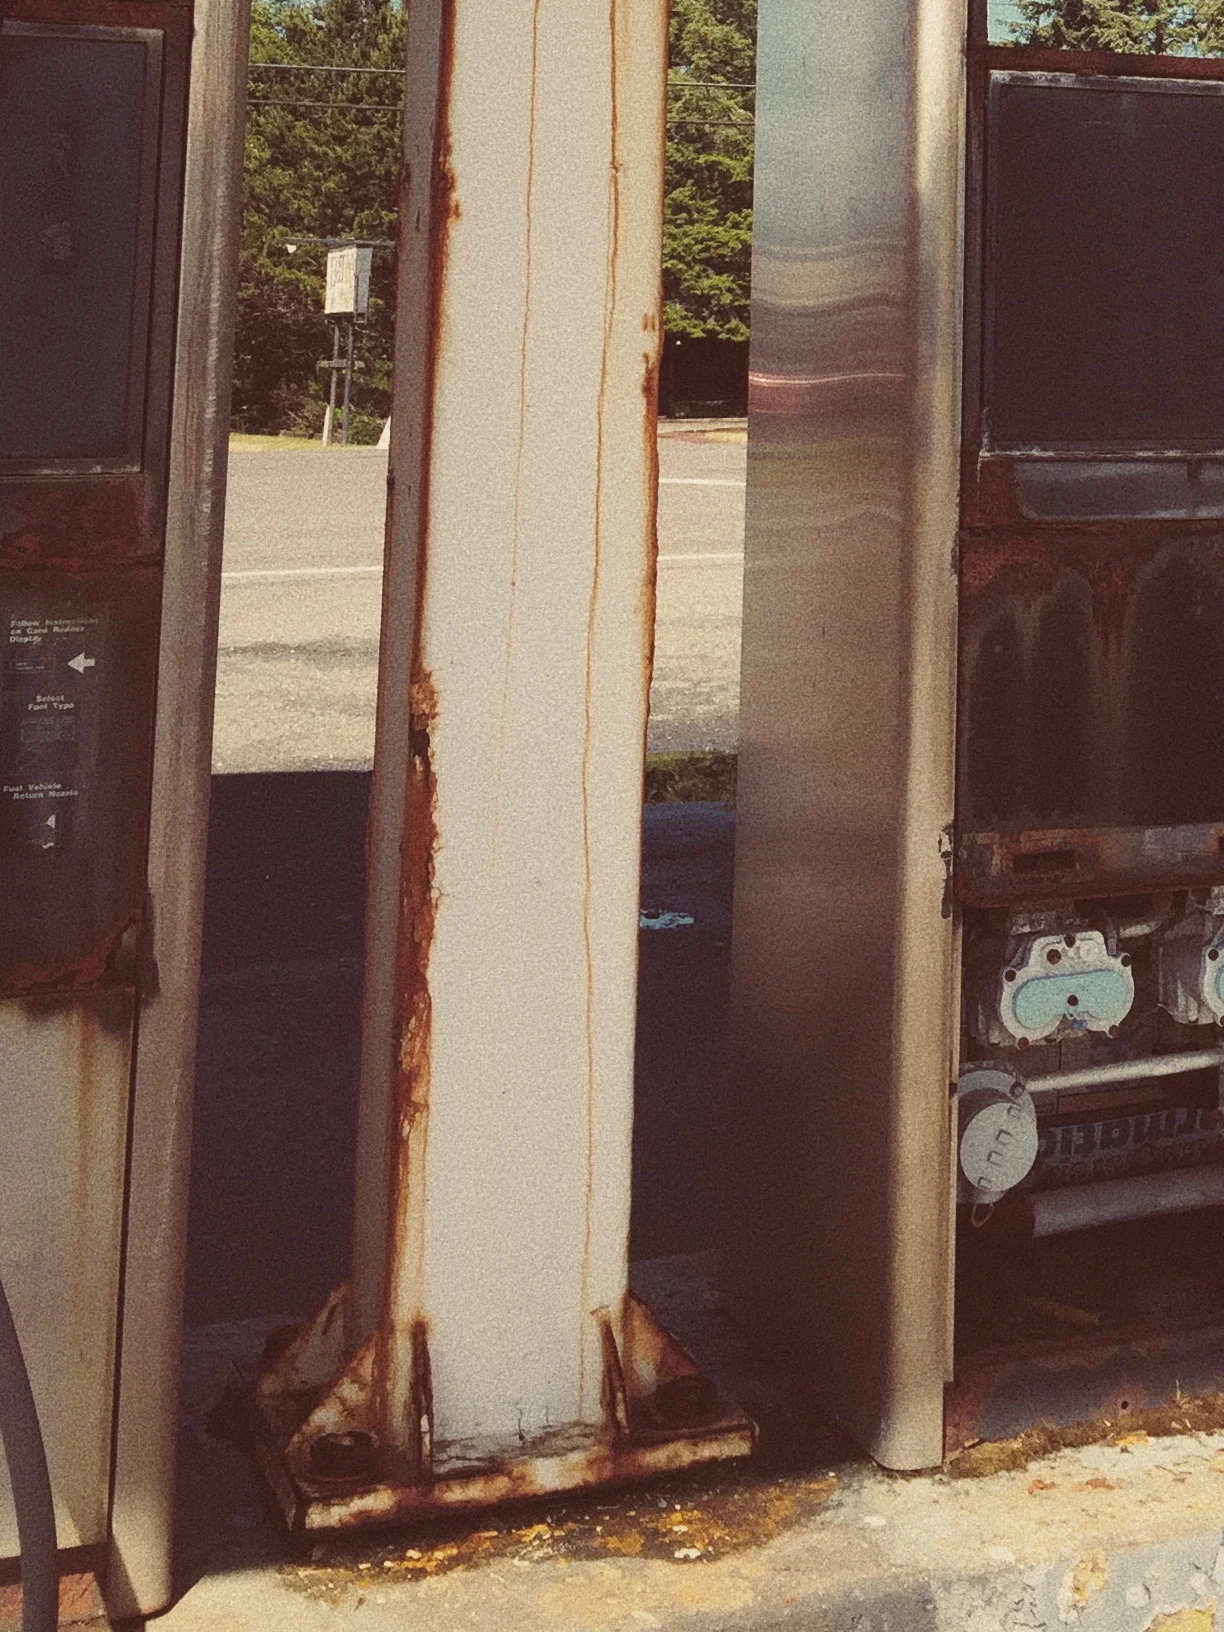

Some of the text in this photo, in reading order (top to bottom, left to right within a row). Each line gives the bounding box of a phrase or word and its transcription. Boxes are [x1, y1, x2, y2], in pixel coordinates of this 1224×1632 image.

[36, 695, 65, 703] Select
[27, 701, 75, 711] Fuel Type
[3, 784, 23, 792] Fuel
[13, 792, 44, 800] Return
